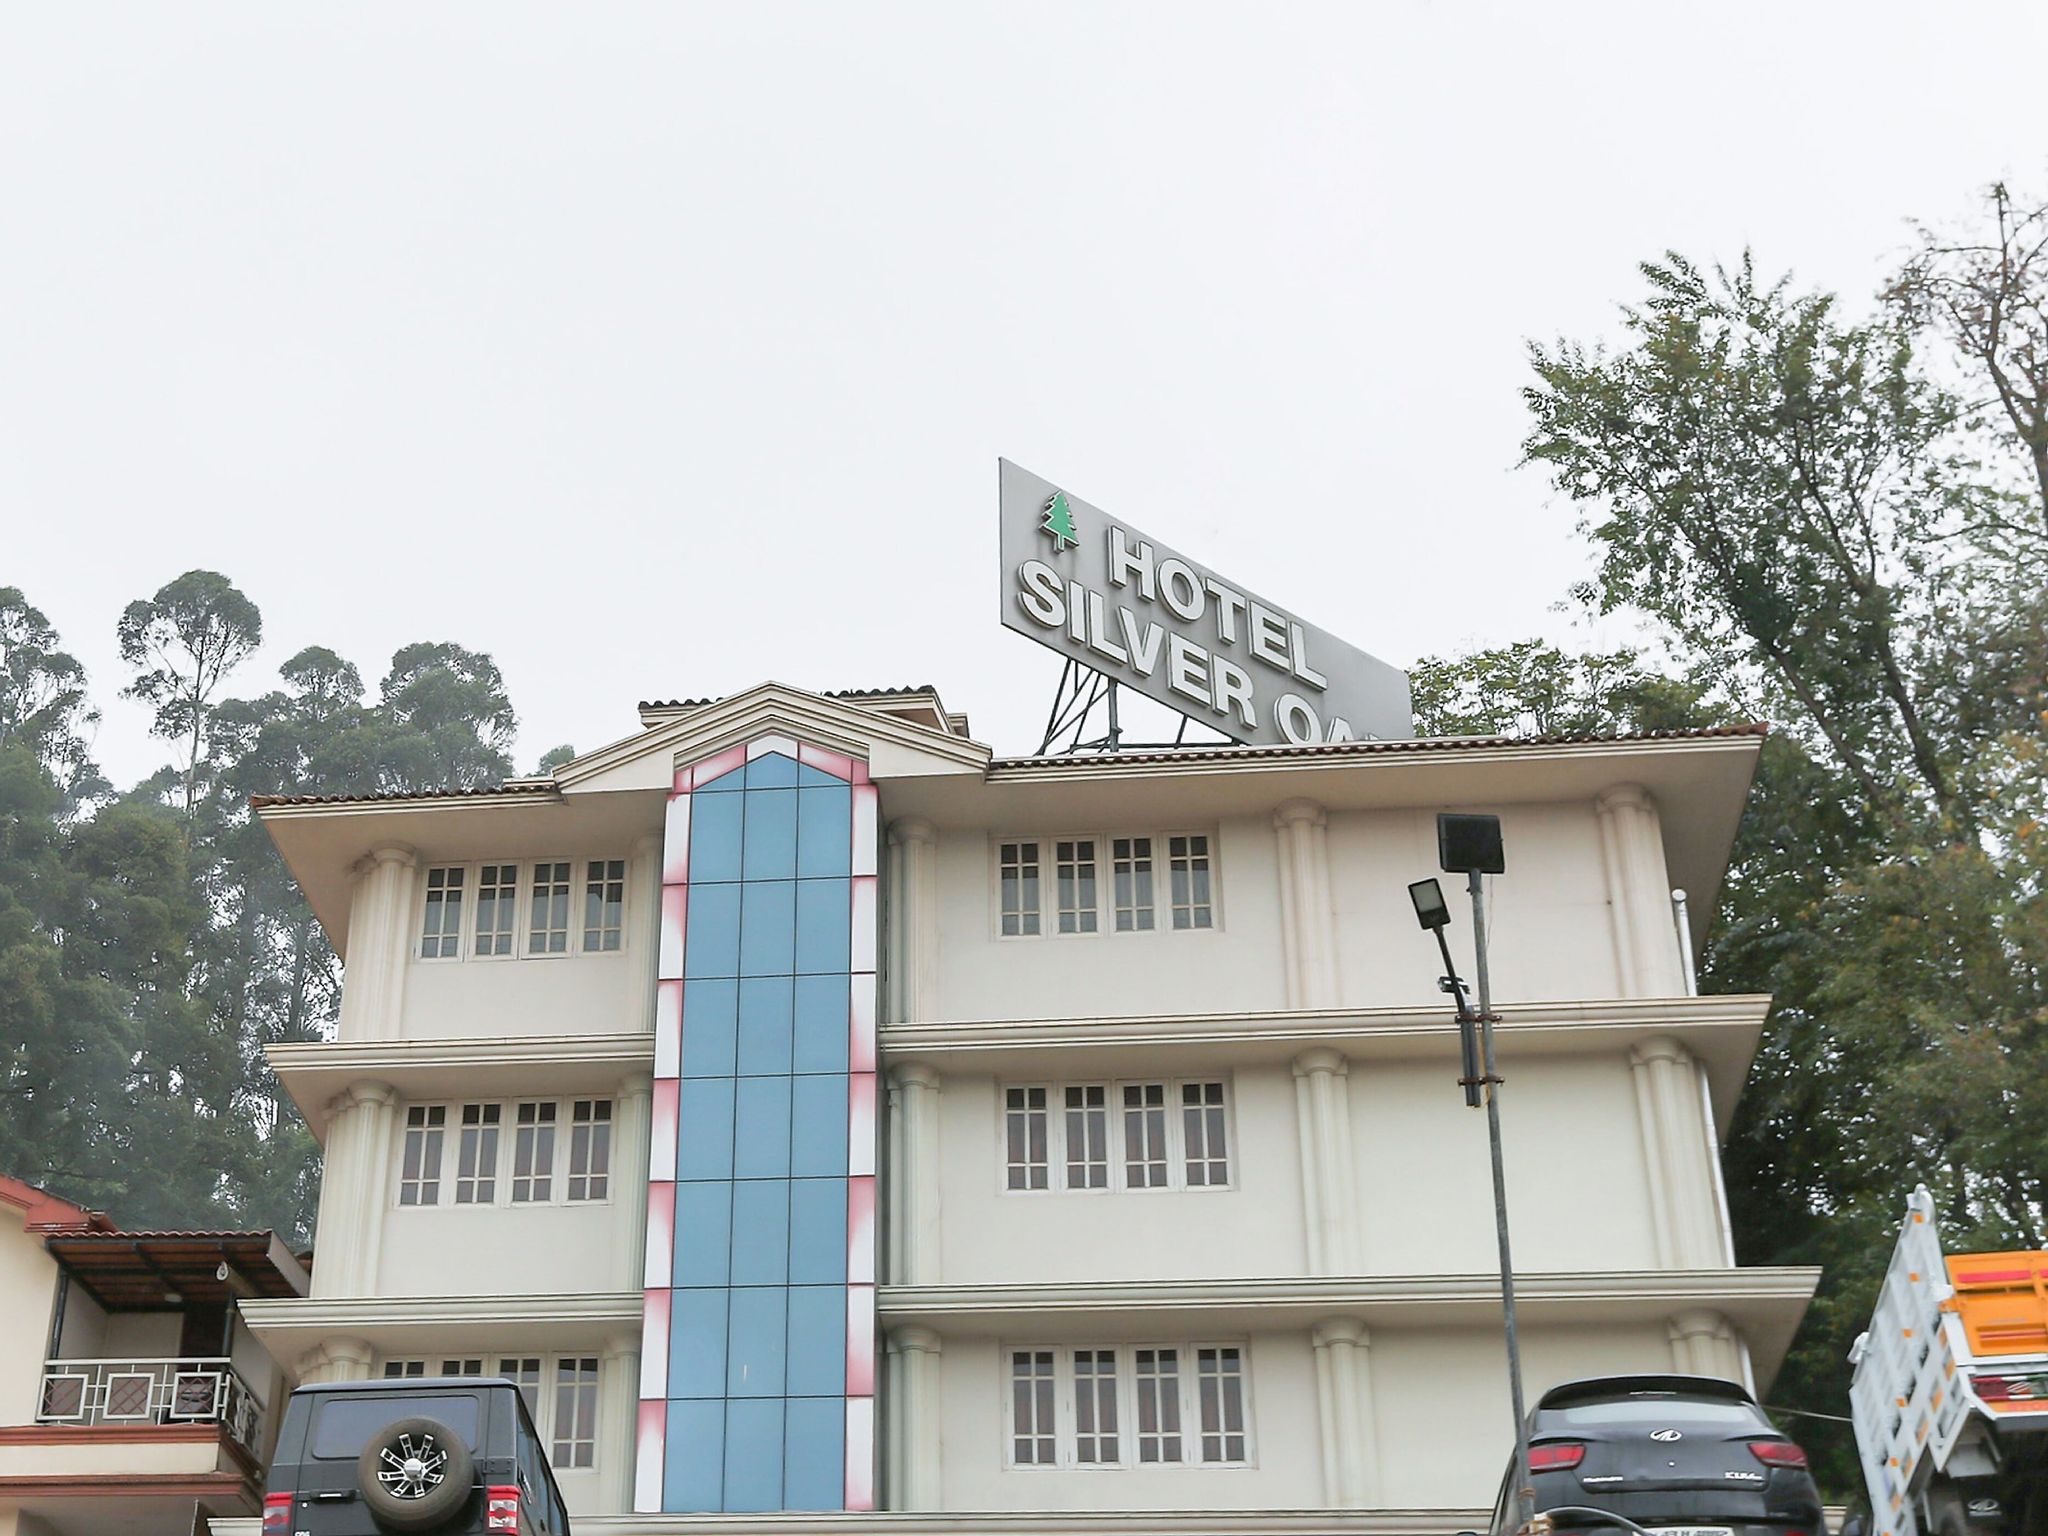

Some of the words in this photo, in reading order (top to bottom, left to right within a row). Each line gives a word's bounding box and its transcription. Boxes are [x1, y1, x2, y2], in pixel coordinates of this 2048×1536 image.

[1018, 559, 1258, 730] SILVER
[1274, 693, 1380, 744] OA
[1107, 525, 1328, 692] HOTEL
